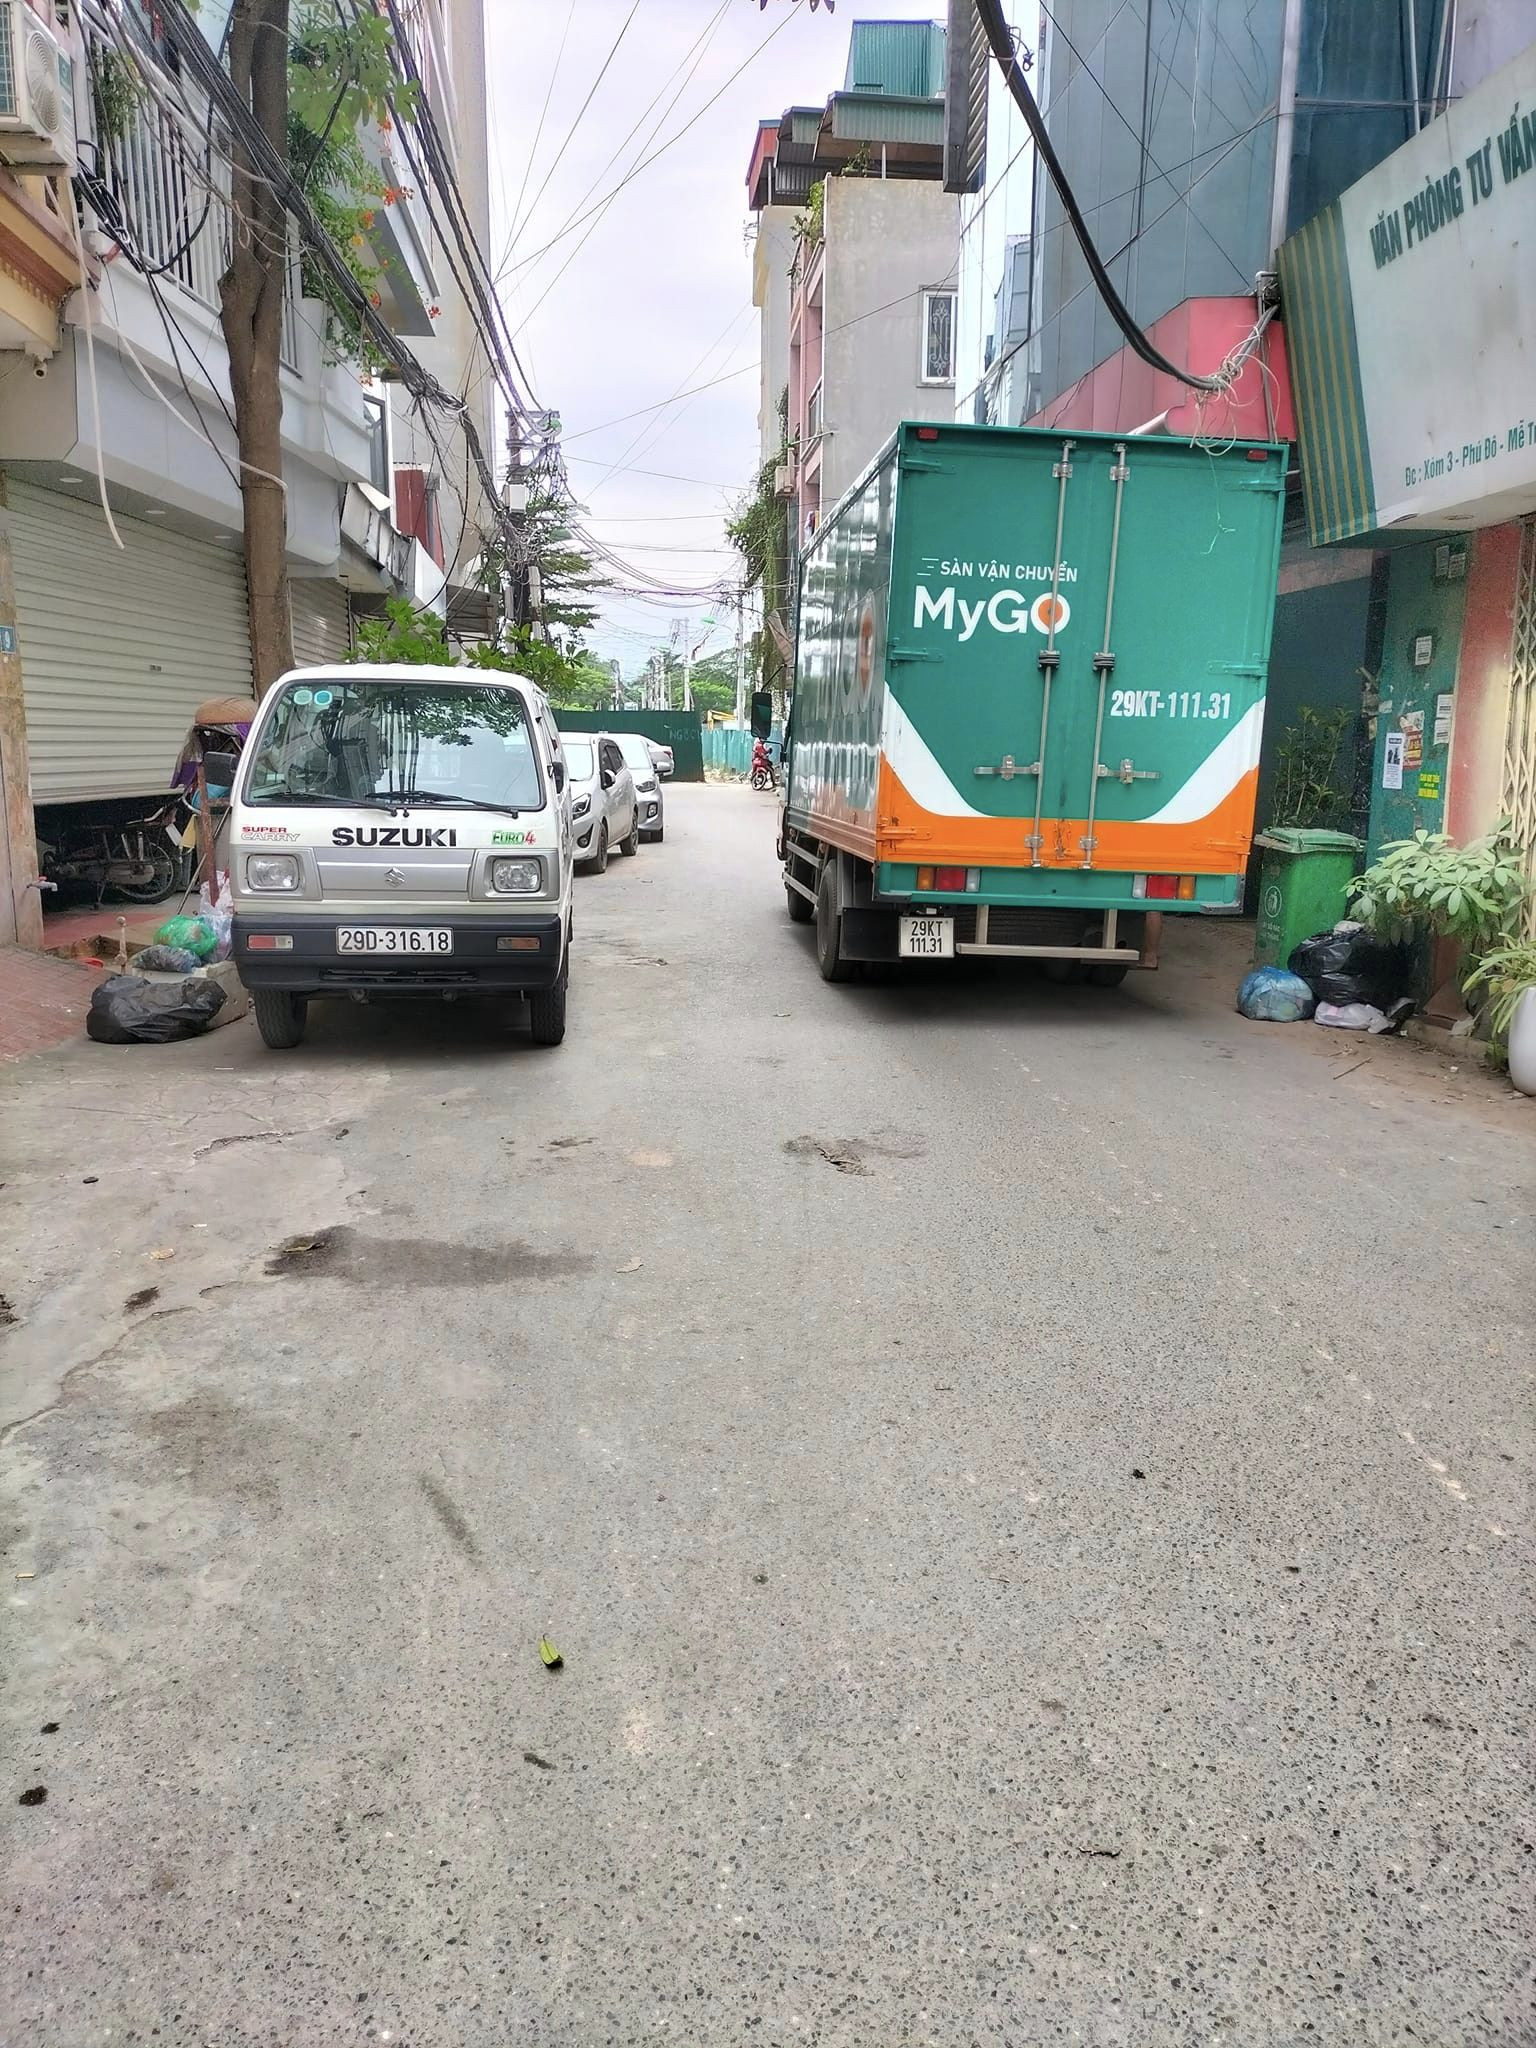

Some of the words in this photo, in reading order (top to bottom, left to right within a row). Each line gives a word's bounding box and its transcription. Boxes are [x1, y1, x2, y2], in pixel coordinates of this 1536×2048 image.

[1369, 210, 1403, 270] VĂN
[1403, 166, 1464, 249] PHÒNG
[1466, 136, 1493, 206] TƯ
[1424, 456, 1444, 480] Xóm
[1447, 450, 1453, 472] 3
[1462, 440, 1482, 468] Phú
[1484, 434, 1497, 460] Đô
[940, 558, 974, 577] SÀN
[978, 559, 1010, 582] VẬN
[1015, 561, 1078, 583] CHUYỂN
[913, 585, 1071, 642] MyGO
[1110, 690, 1231, 719] 29KT-111.31
[240, 832, 301, 841] CARRY
[332, 827, 457, 847] SUZUKI
[911, 920, 943, 937] 29KT
[340, 930, 449, 951] 29D-316.18
[909, 937, 943, 953] 111.31
